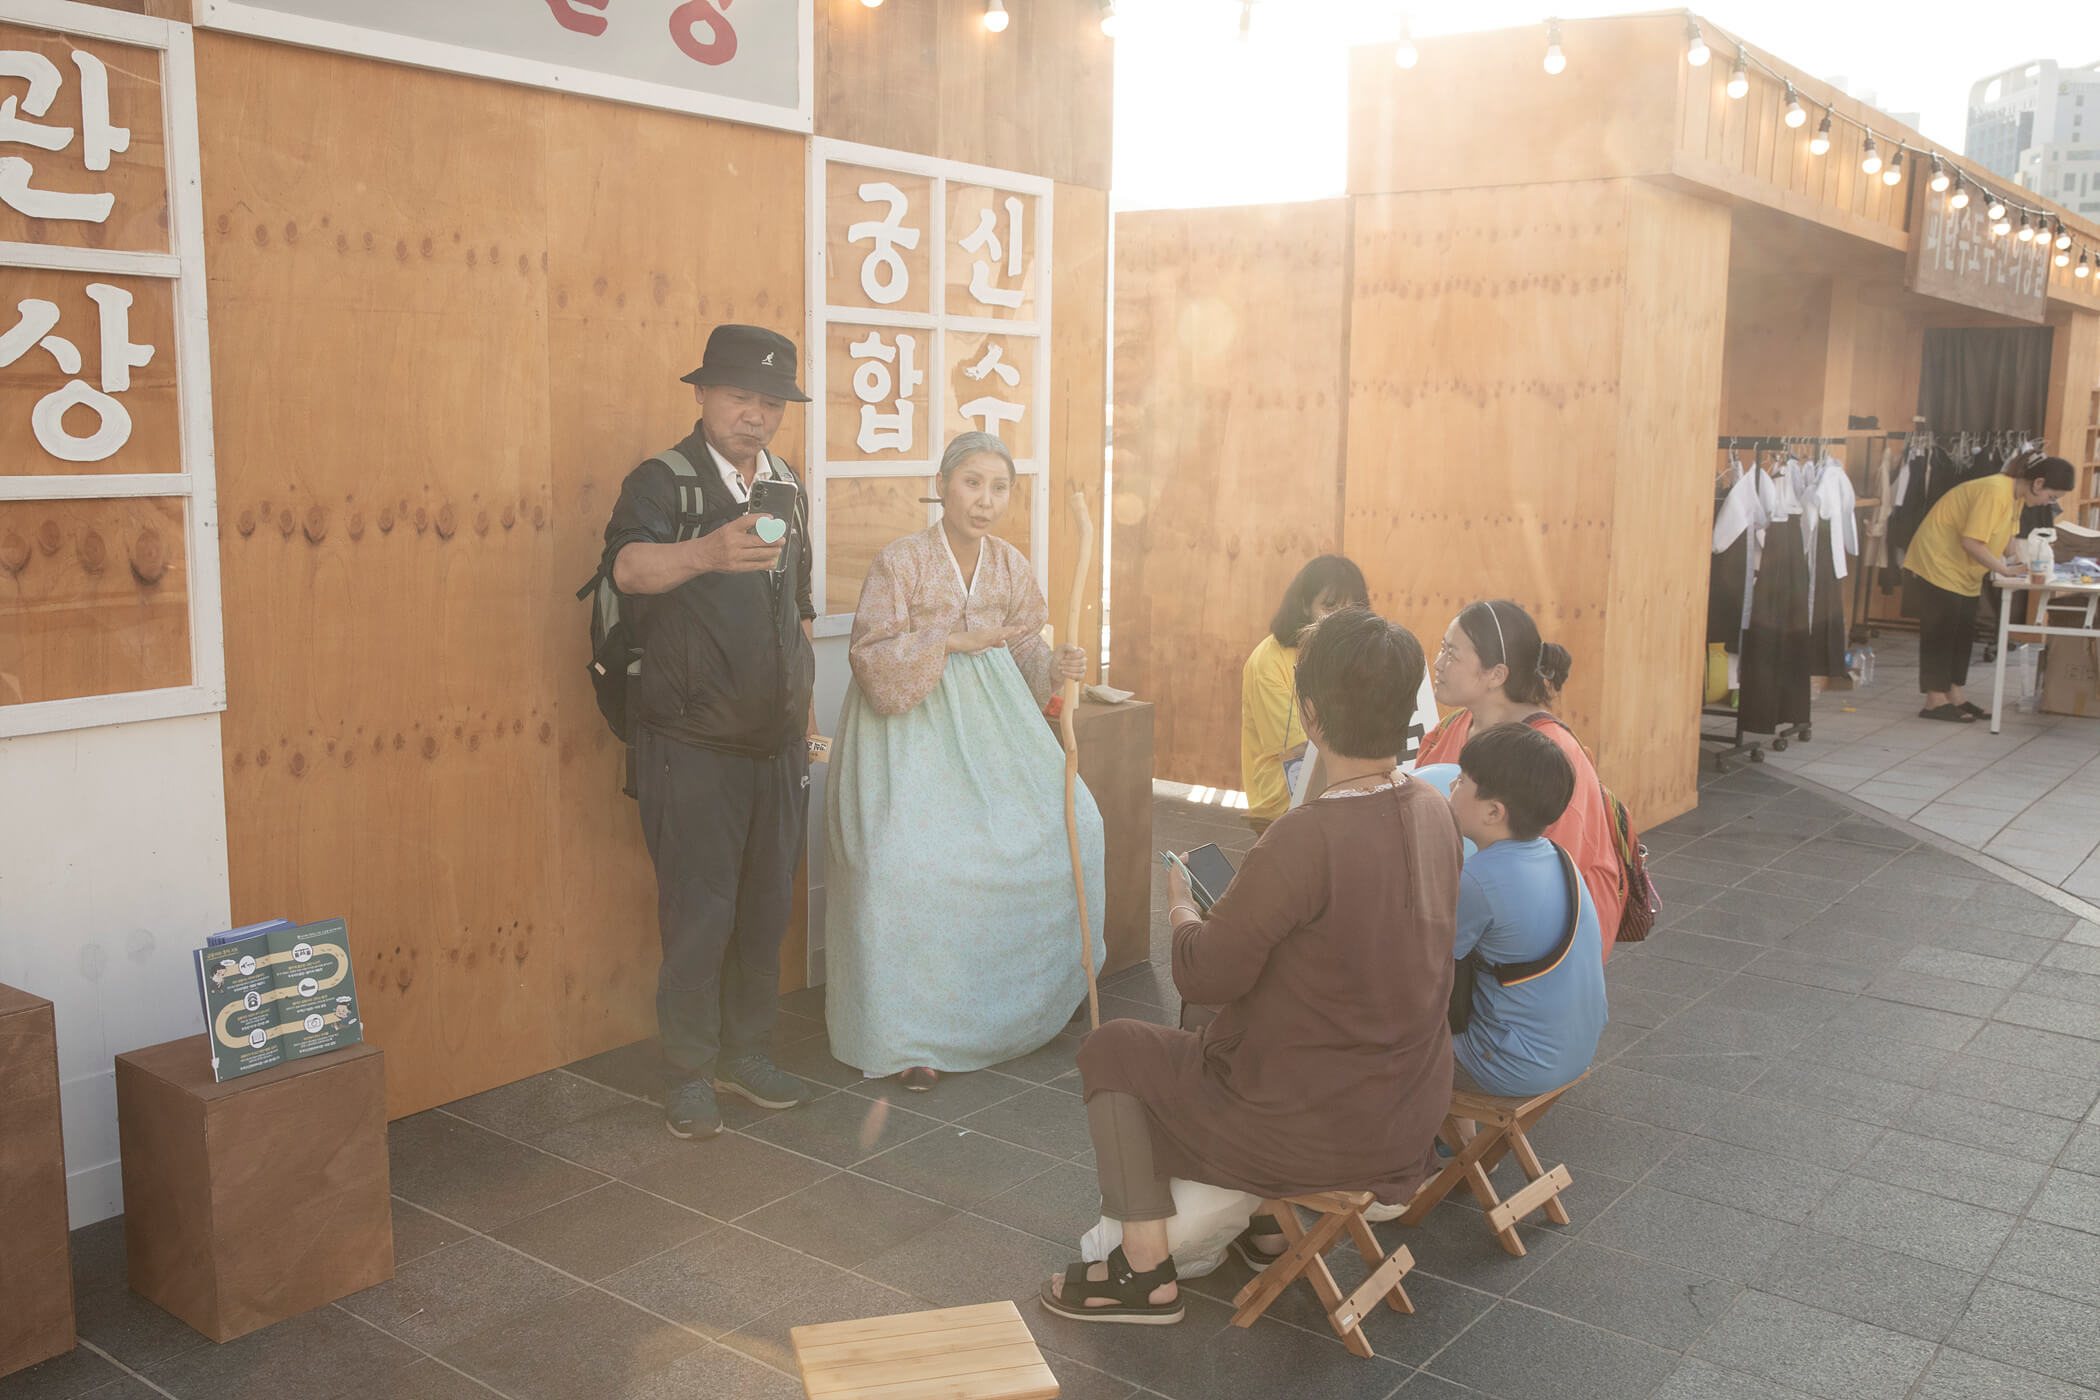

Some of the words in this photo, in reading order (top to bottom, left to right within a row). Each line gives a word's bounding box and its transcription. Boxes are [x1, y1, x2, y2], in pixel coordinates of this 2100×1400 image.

[0, 49, 156, 463] 관상
[847, 181, 923, 454] 궁합
[957, 195, 1027, 437] 신수
